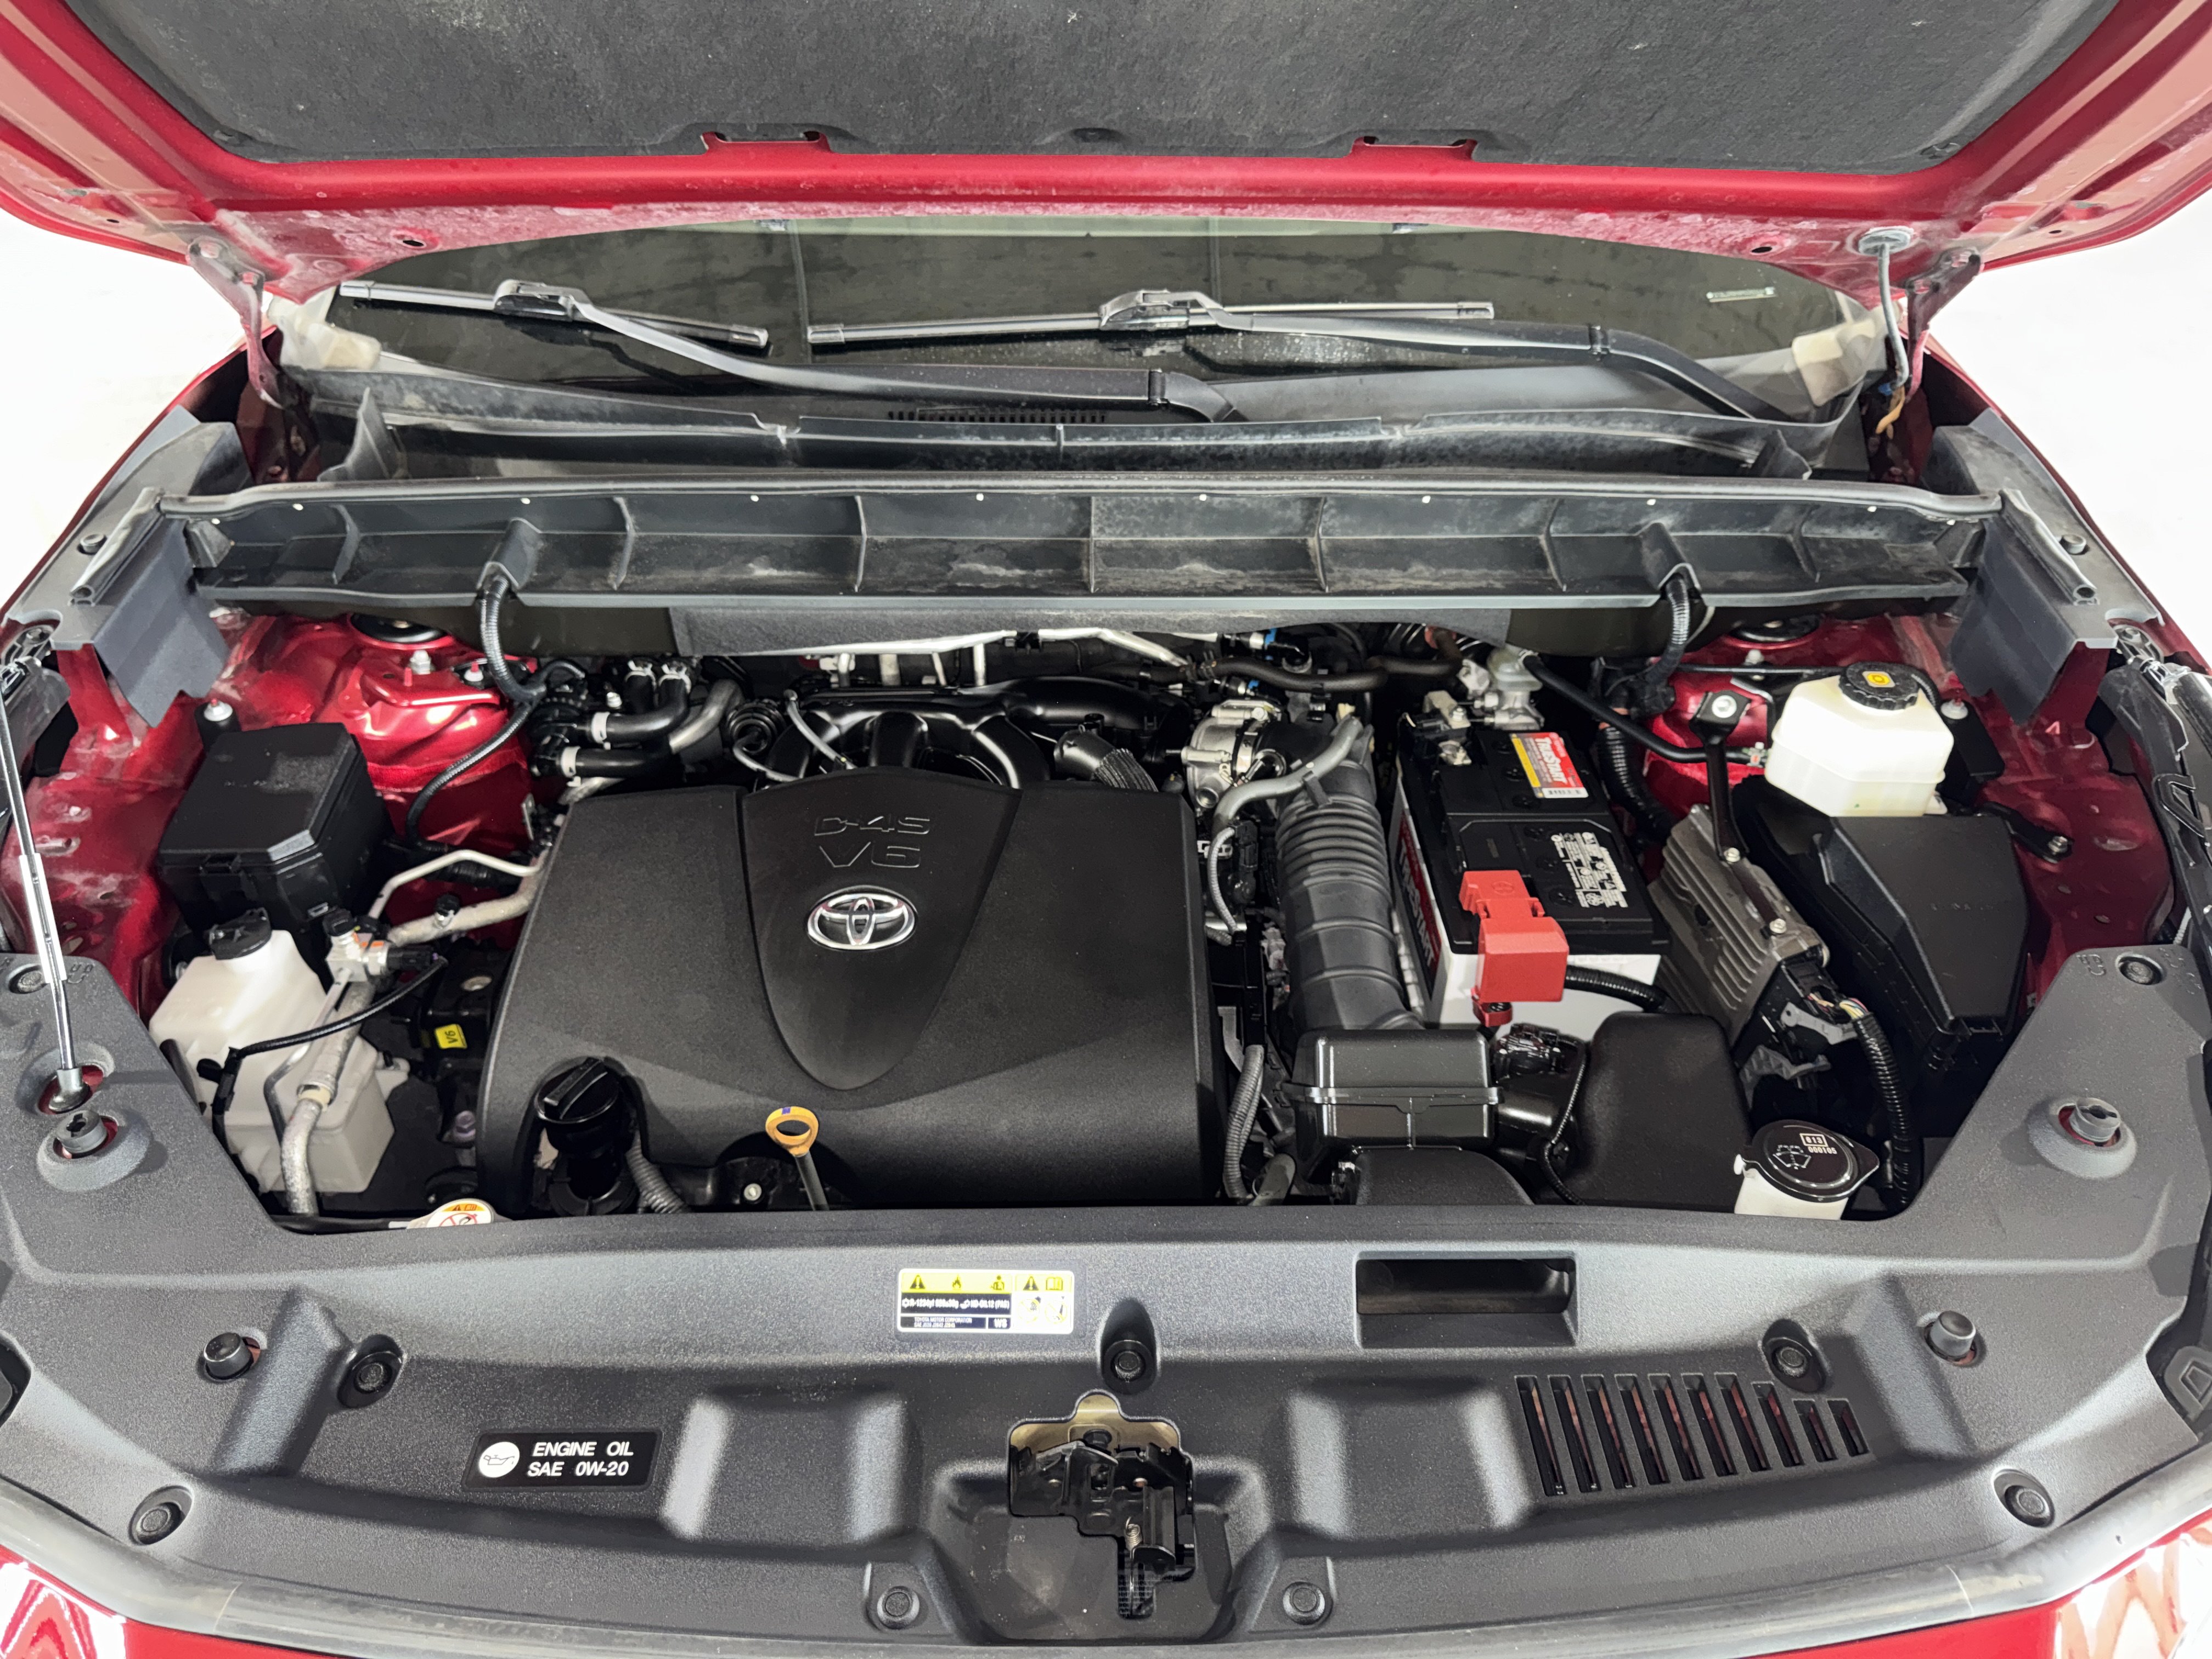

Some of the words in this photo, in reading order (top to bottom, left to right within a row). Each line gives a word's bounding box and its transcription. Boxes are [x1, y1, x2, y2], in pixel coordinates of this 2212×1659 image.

[819, 841, 921, 868] V6
[444, 1030, 458, 1044] V6
[1808, 1146, 1837, 1154] 000105
[532, 1441, 597, 1457] ENGINE
[606, 1441, 634, 1457] OIL
[527, 1461, 565, 1476] SAE
[574, 1461, 629, 1476] 0W-20
